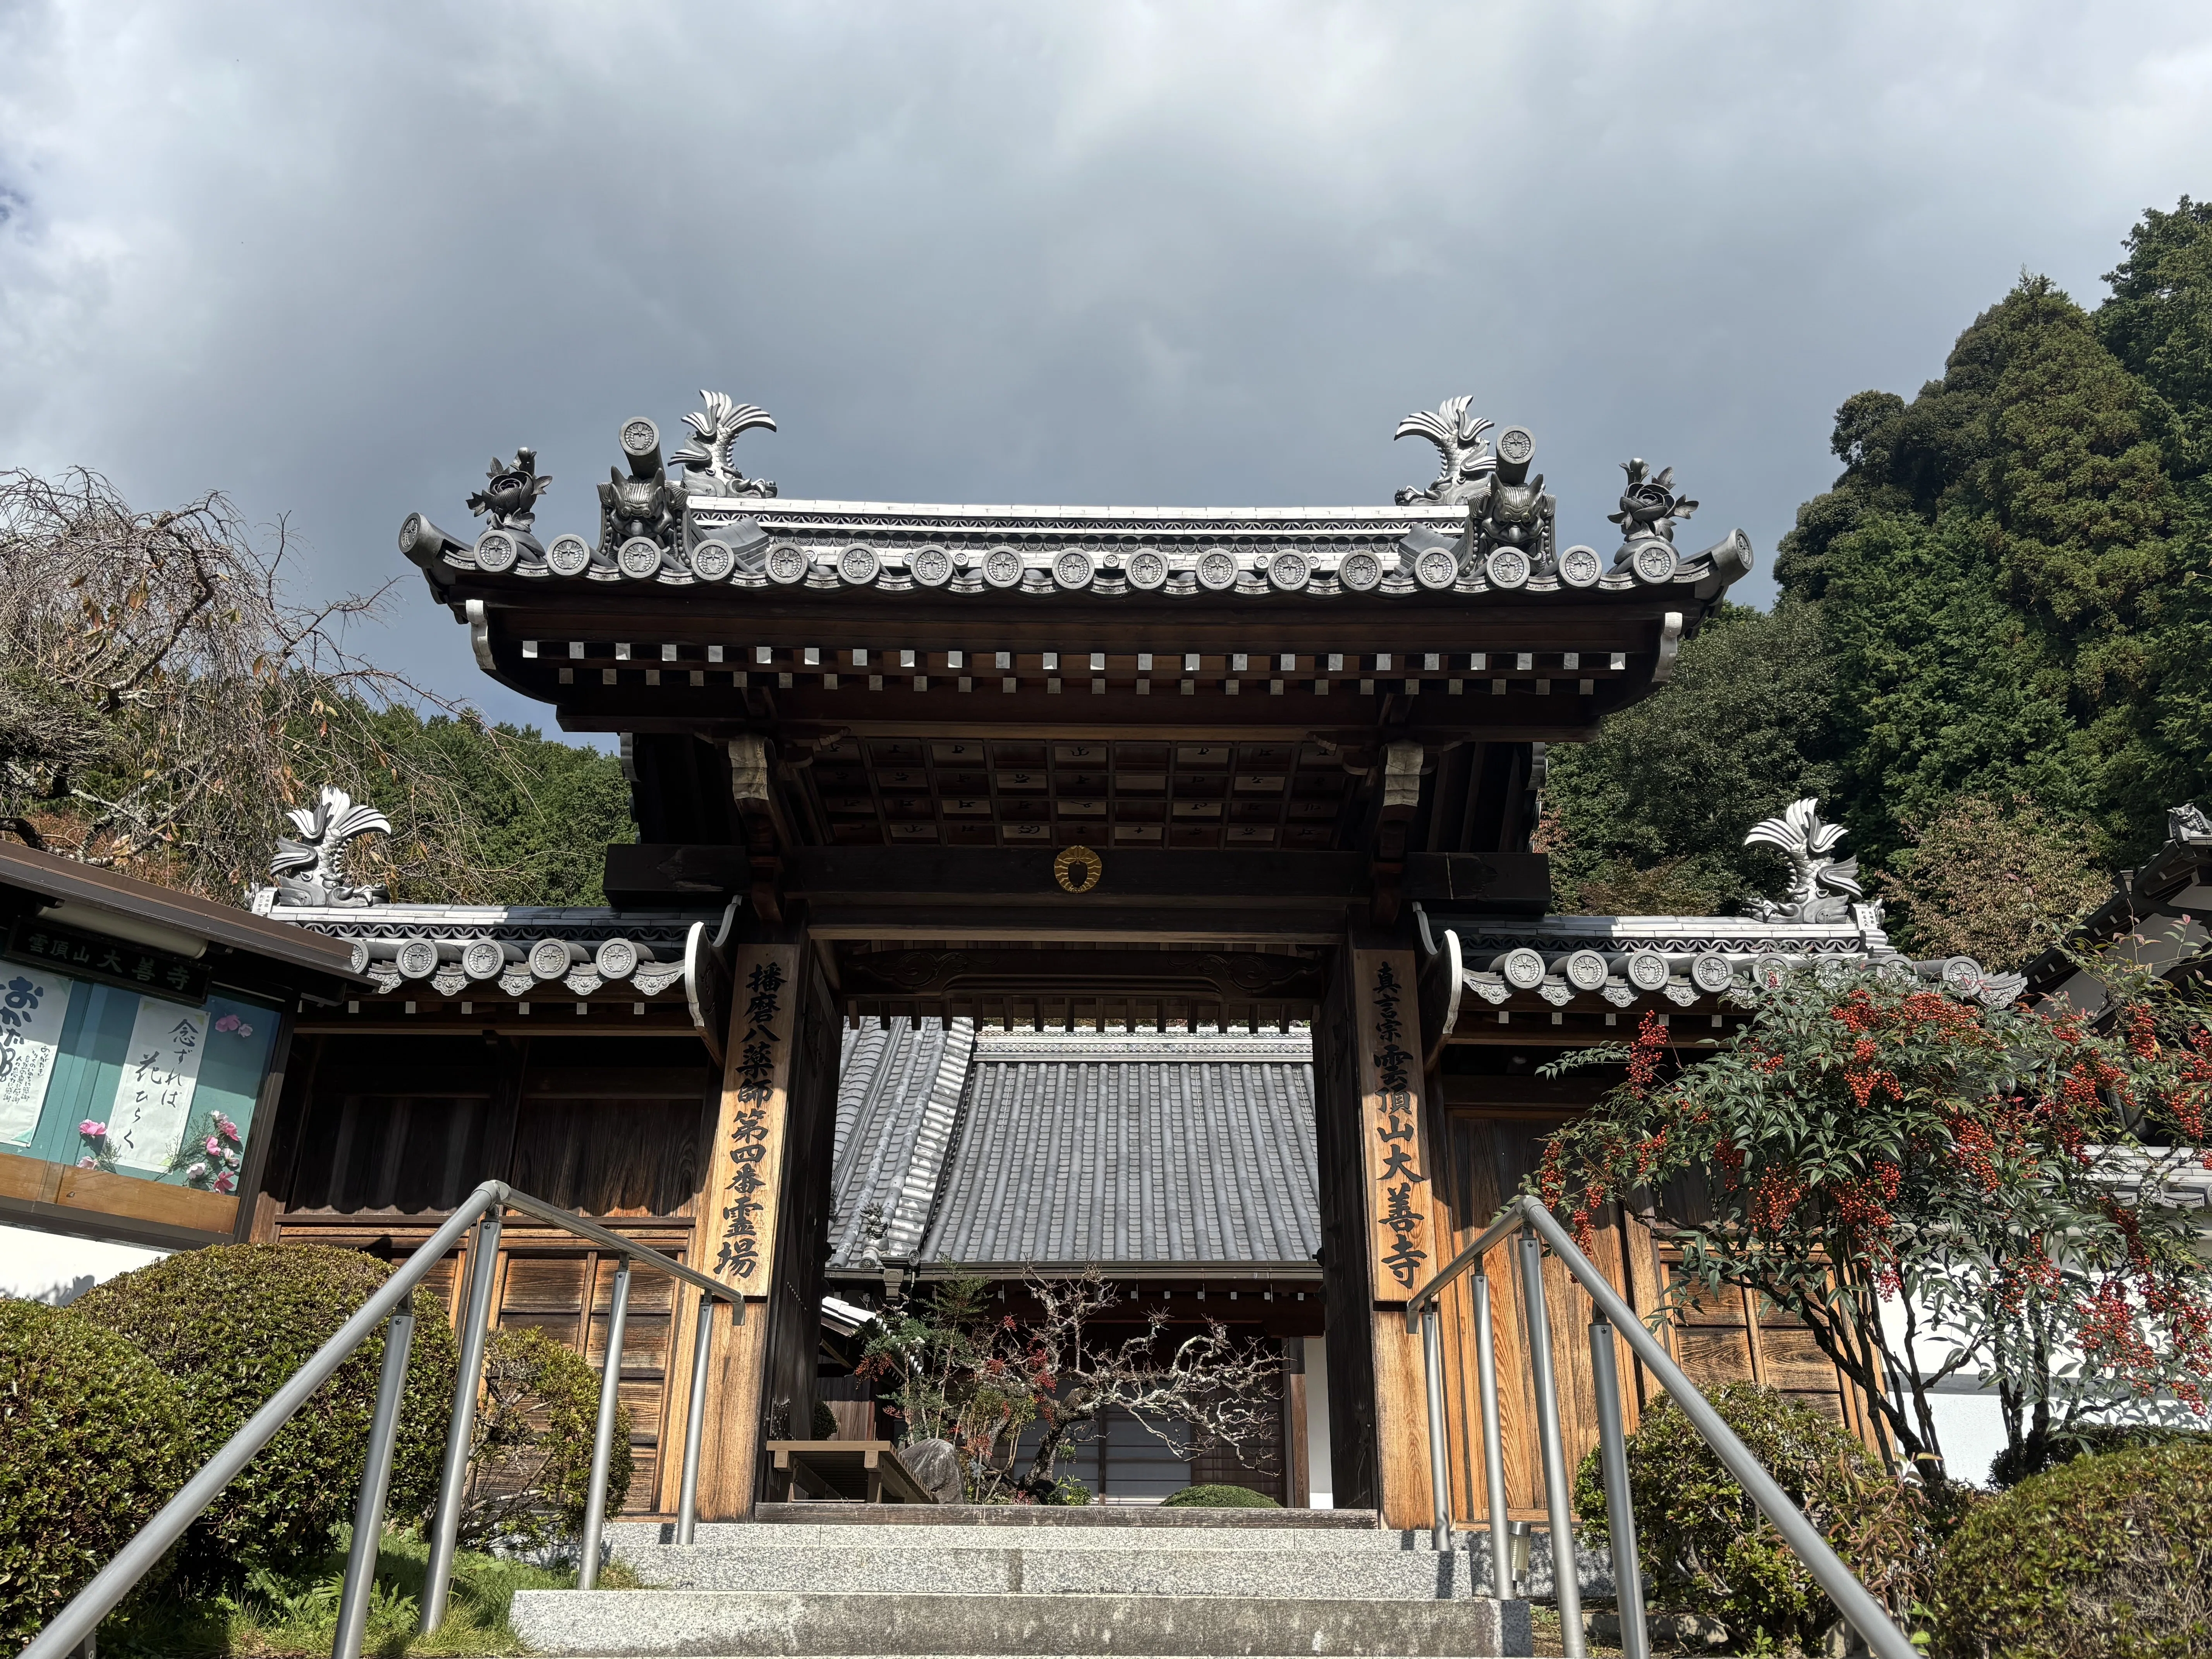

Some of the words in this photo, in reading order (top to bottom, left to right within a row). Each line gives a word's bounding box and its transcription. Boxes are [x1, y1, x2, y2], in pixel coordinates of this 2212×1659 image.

[28, 934, 190, 990] 雲頂山大善寺
[124, 1051, 161, 1149] 花ひらく
[161, 1019, 199, 1108] 念ずれば
[713, 962, 787, 1278] 播磨八薬師第四番霊場
[1373, 961, 1427, 1289] 真言宗雲頂山大善寺
